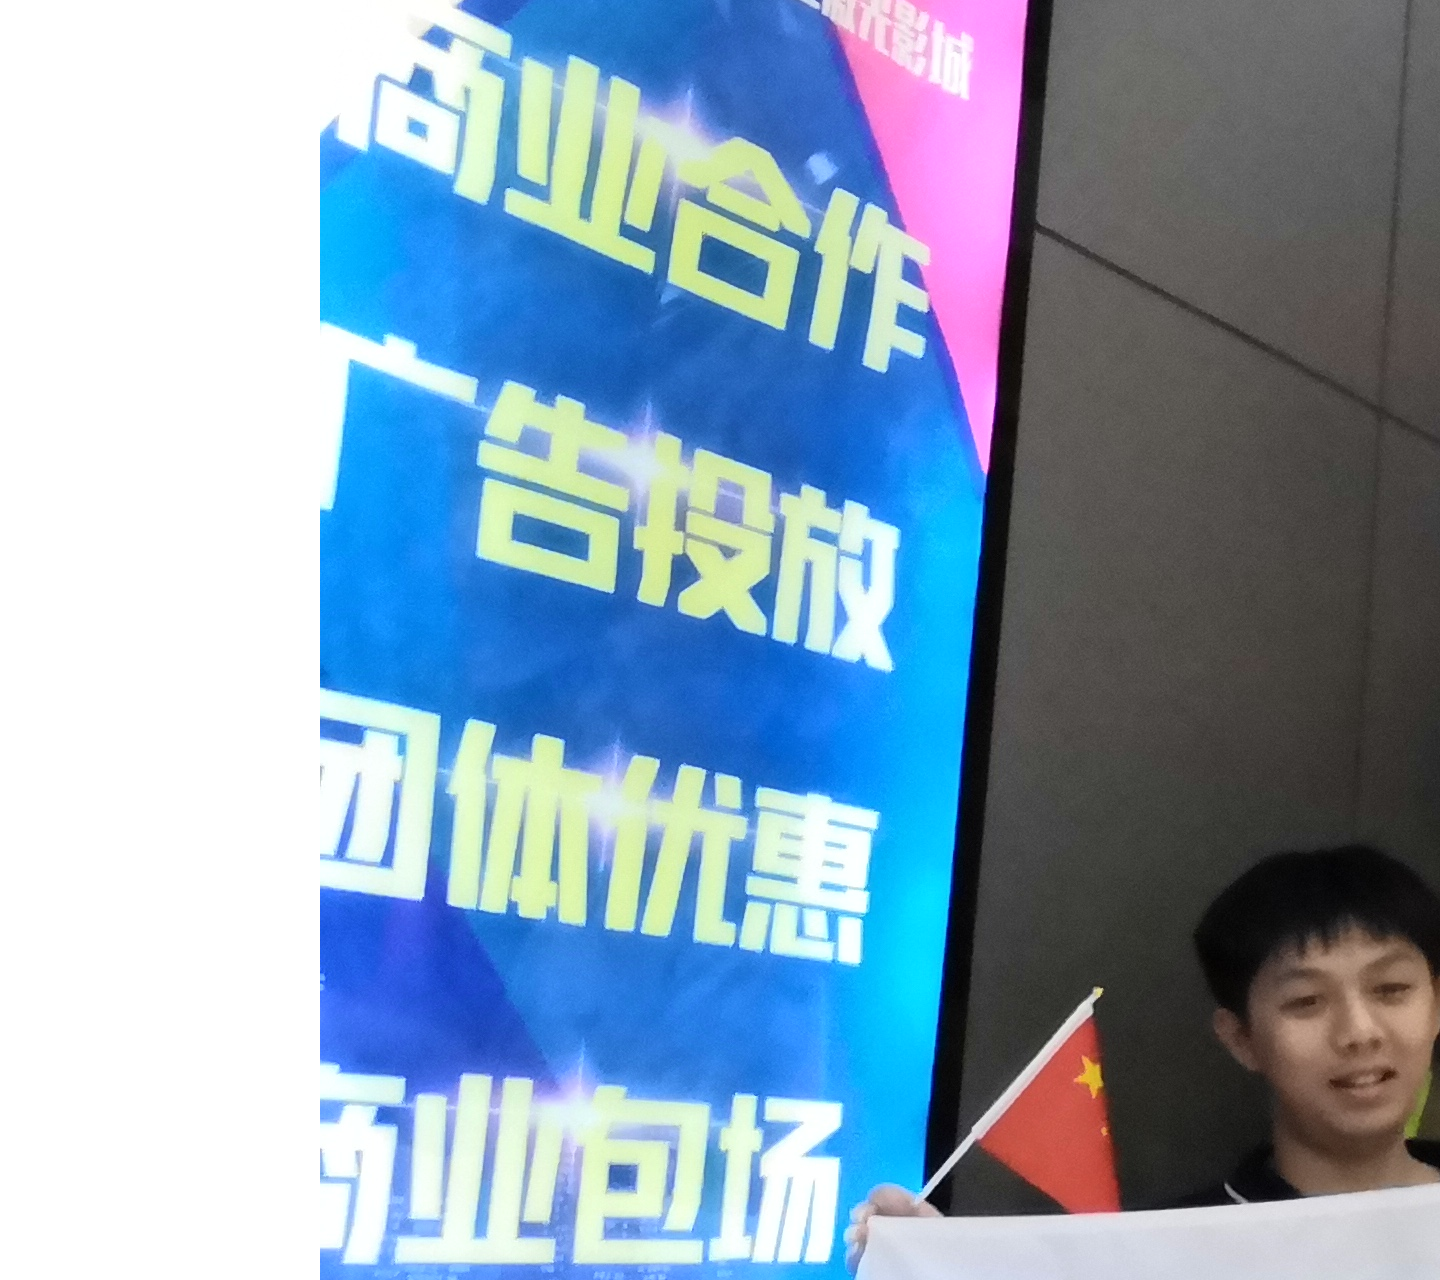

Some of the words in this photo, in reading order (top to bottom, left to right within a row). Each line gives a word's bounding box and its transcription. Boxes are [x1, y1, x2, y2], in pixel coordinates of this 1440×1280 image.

[320, 320, 902, 673] 广告投放
[320, 688, 880, 966] 团体优惠
